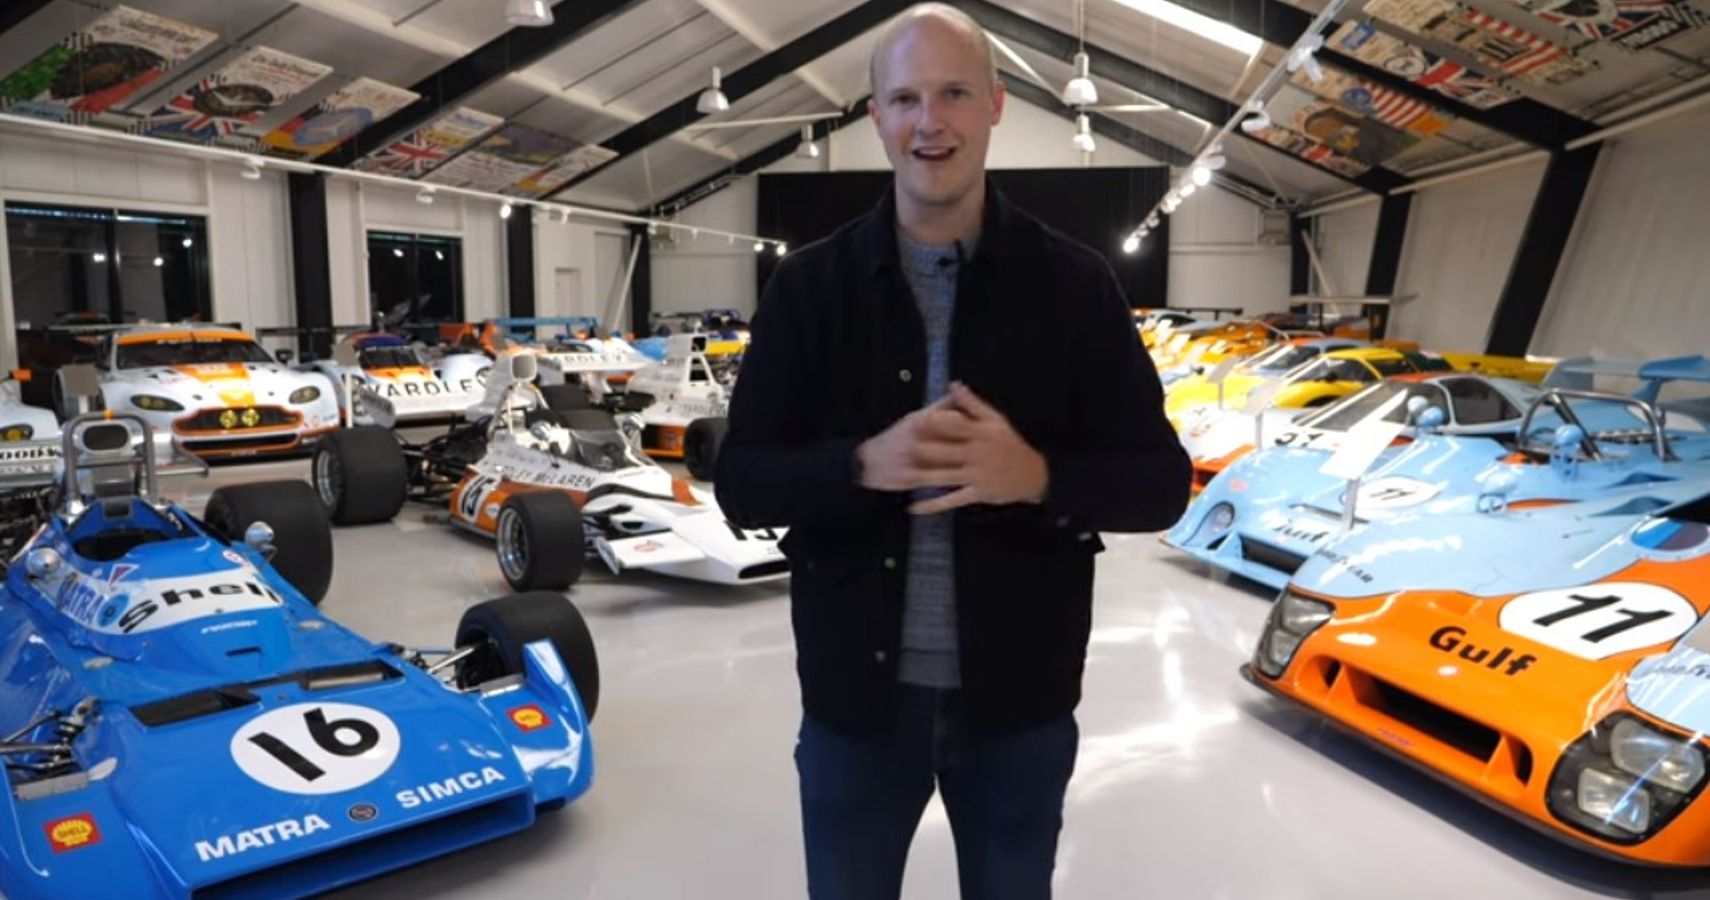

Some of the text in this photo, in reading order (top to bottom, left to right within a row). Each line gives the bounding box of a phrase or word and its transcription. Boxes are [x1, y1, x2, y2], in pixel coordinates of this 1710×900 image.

[118, 581, 282, 633] Shell
[1533, 594, 1676, 643] 11
[1429, 626, 1537, 676] Gulf
[247, 707, 380, 782] 16
[395, 766, 506, 809] SIMCA
[194, 814, 331, 862] MATRA
